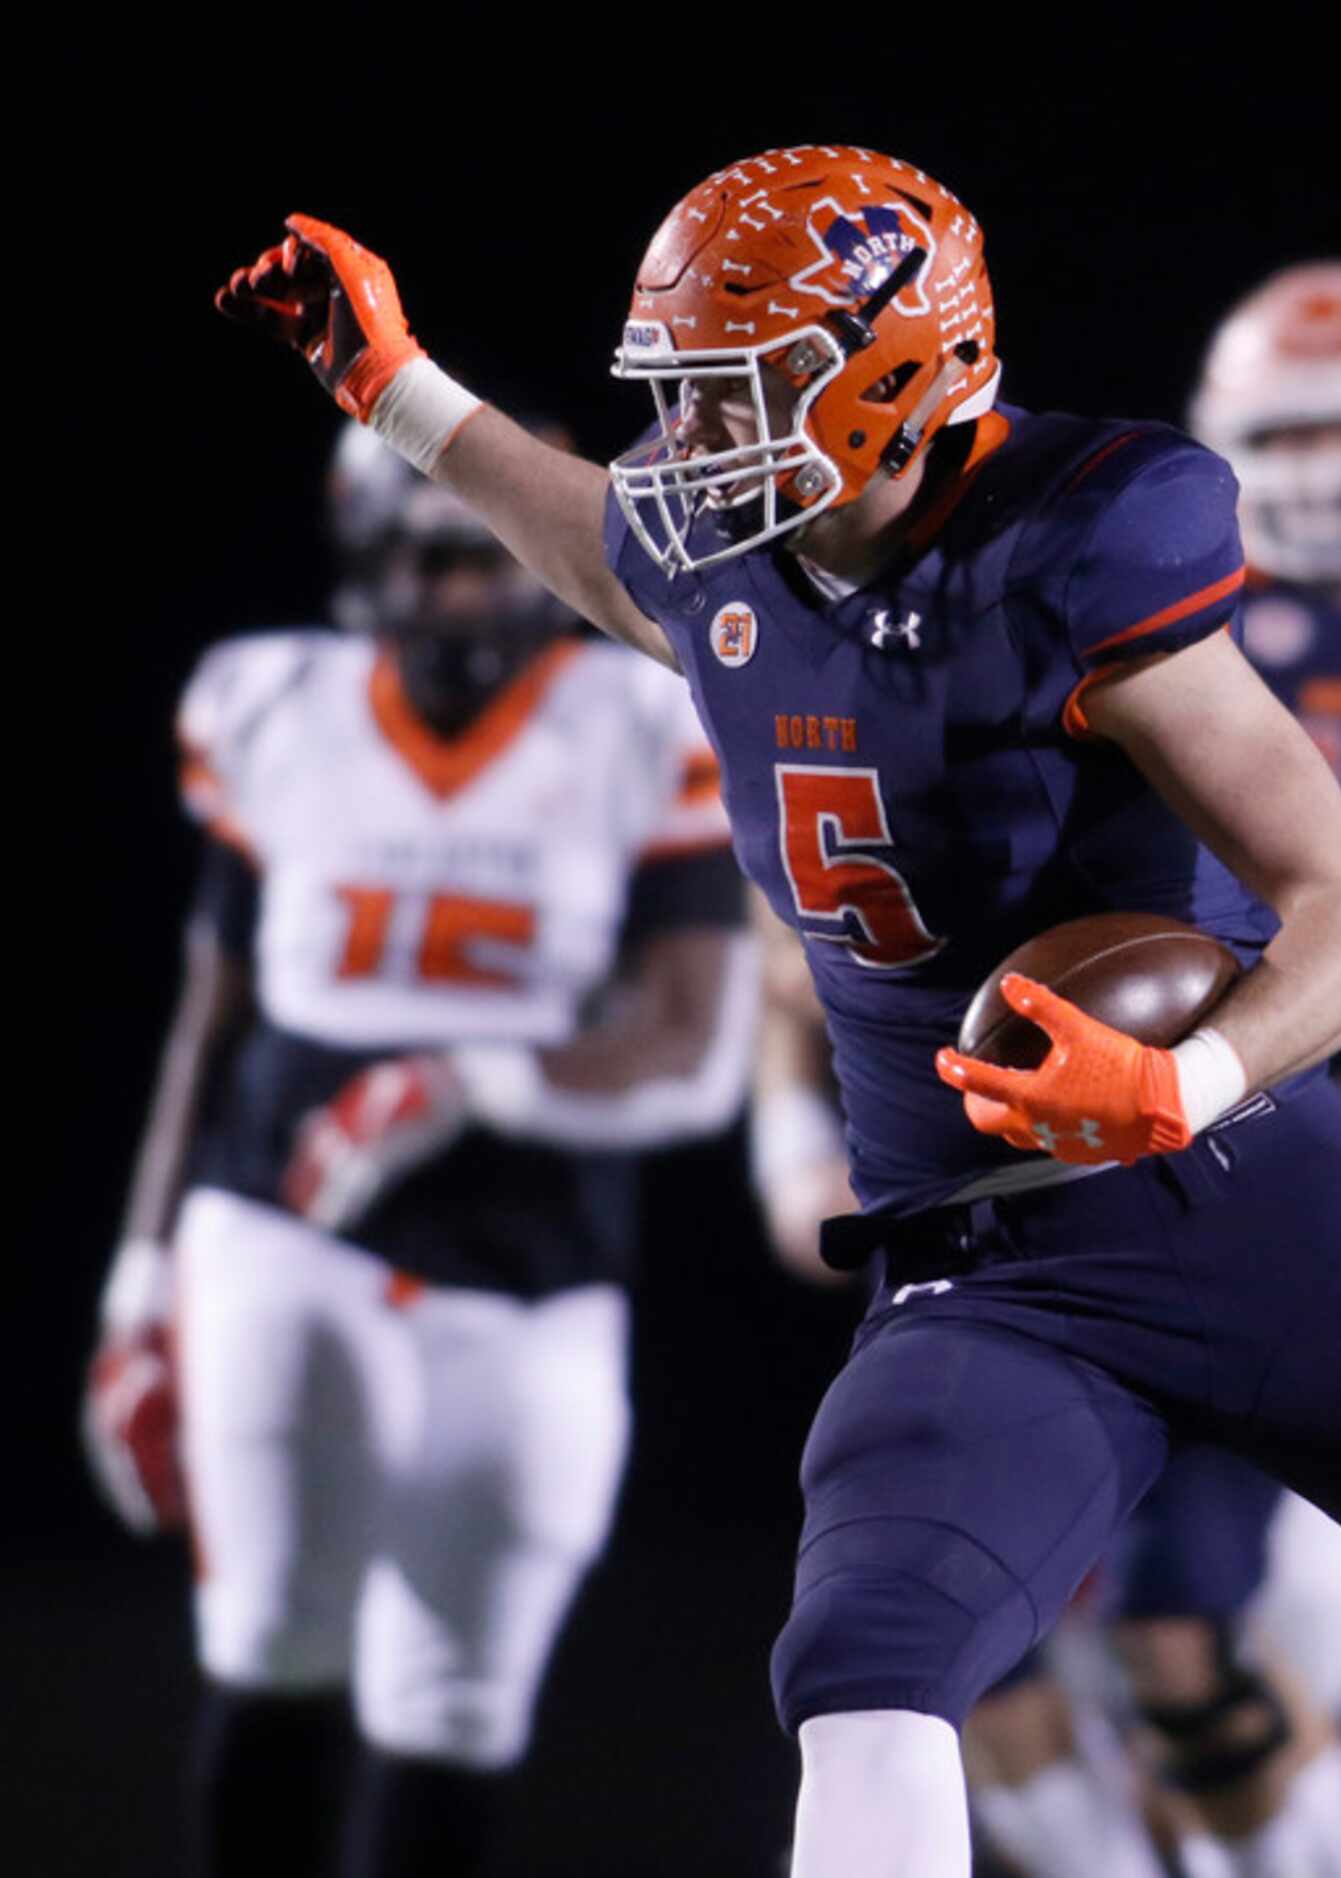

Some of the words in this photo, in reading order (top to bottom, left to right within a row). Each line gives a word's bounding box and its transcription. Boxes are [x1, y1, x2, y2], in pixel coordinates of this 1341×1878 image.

[842, 232, 916, 280] NORTH
[774, 714, 858, 752] NORTH
[774, 763, 946, 969] 5
